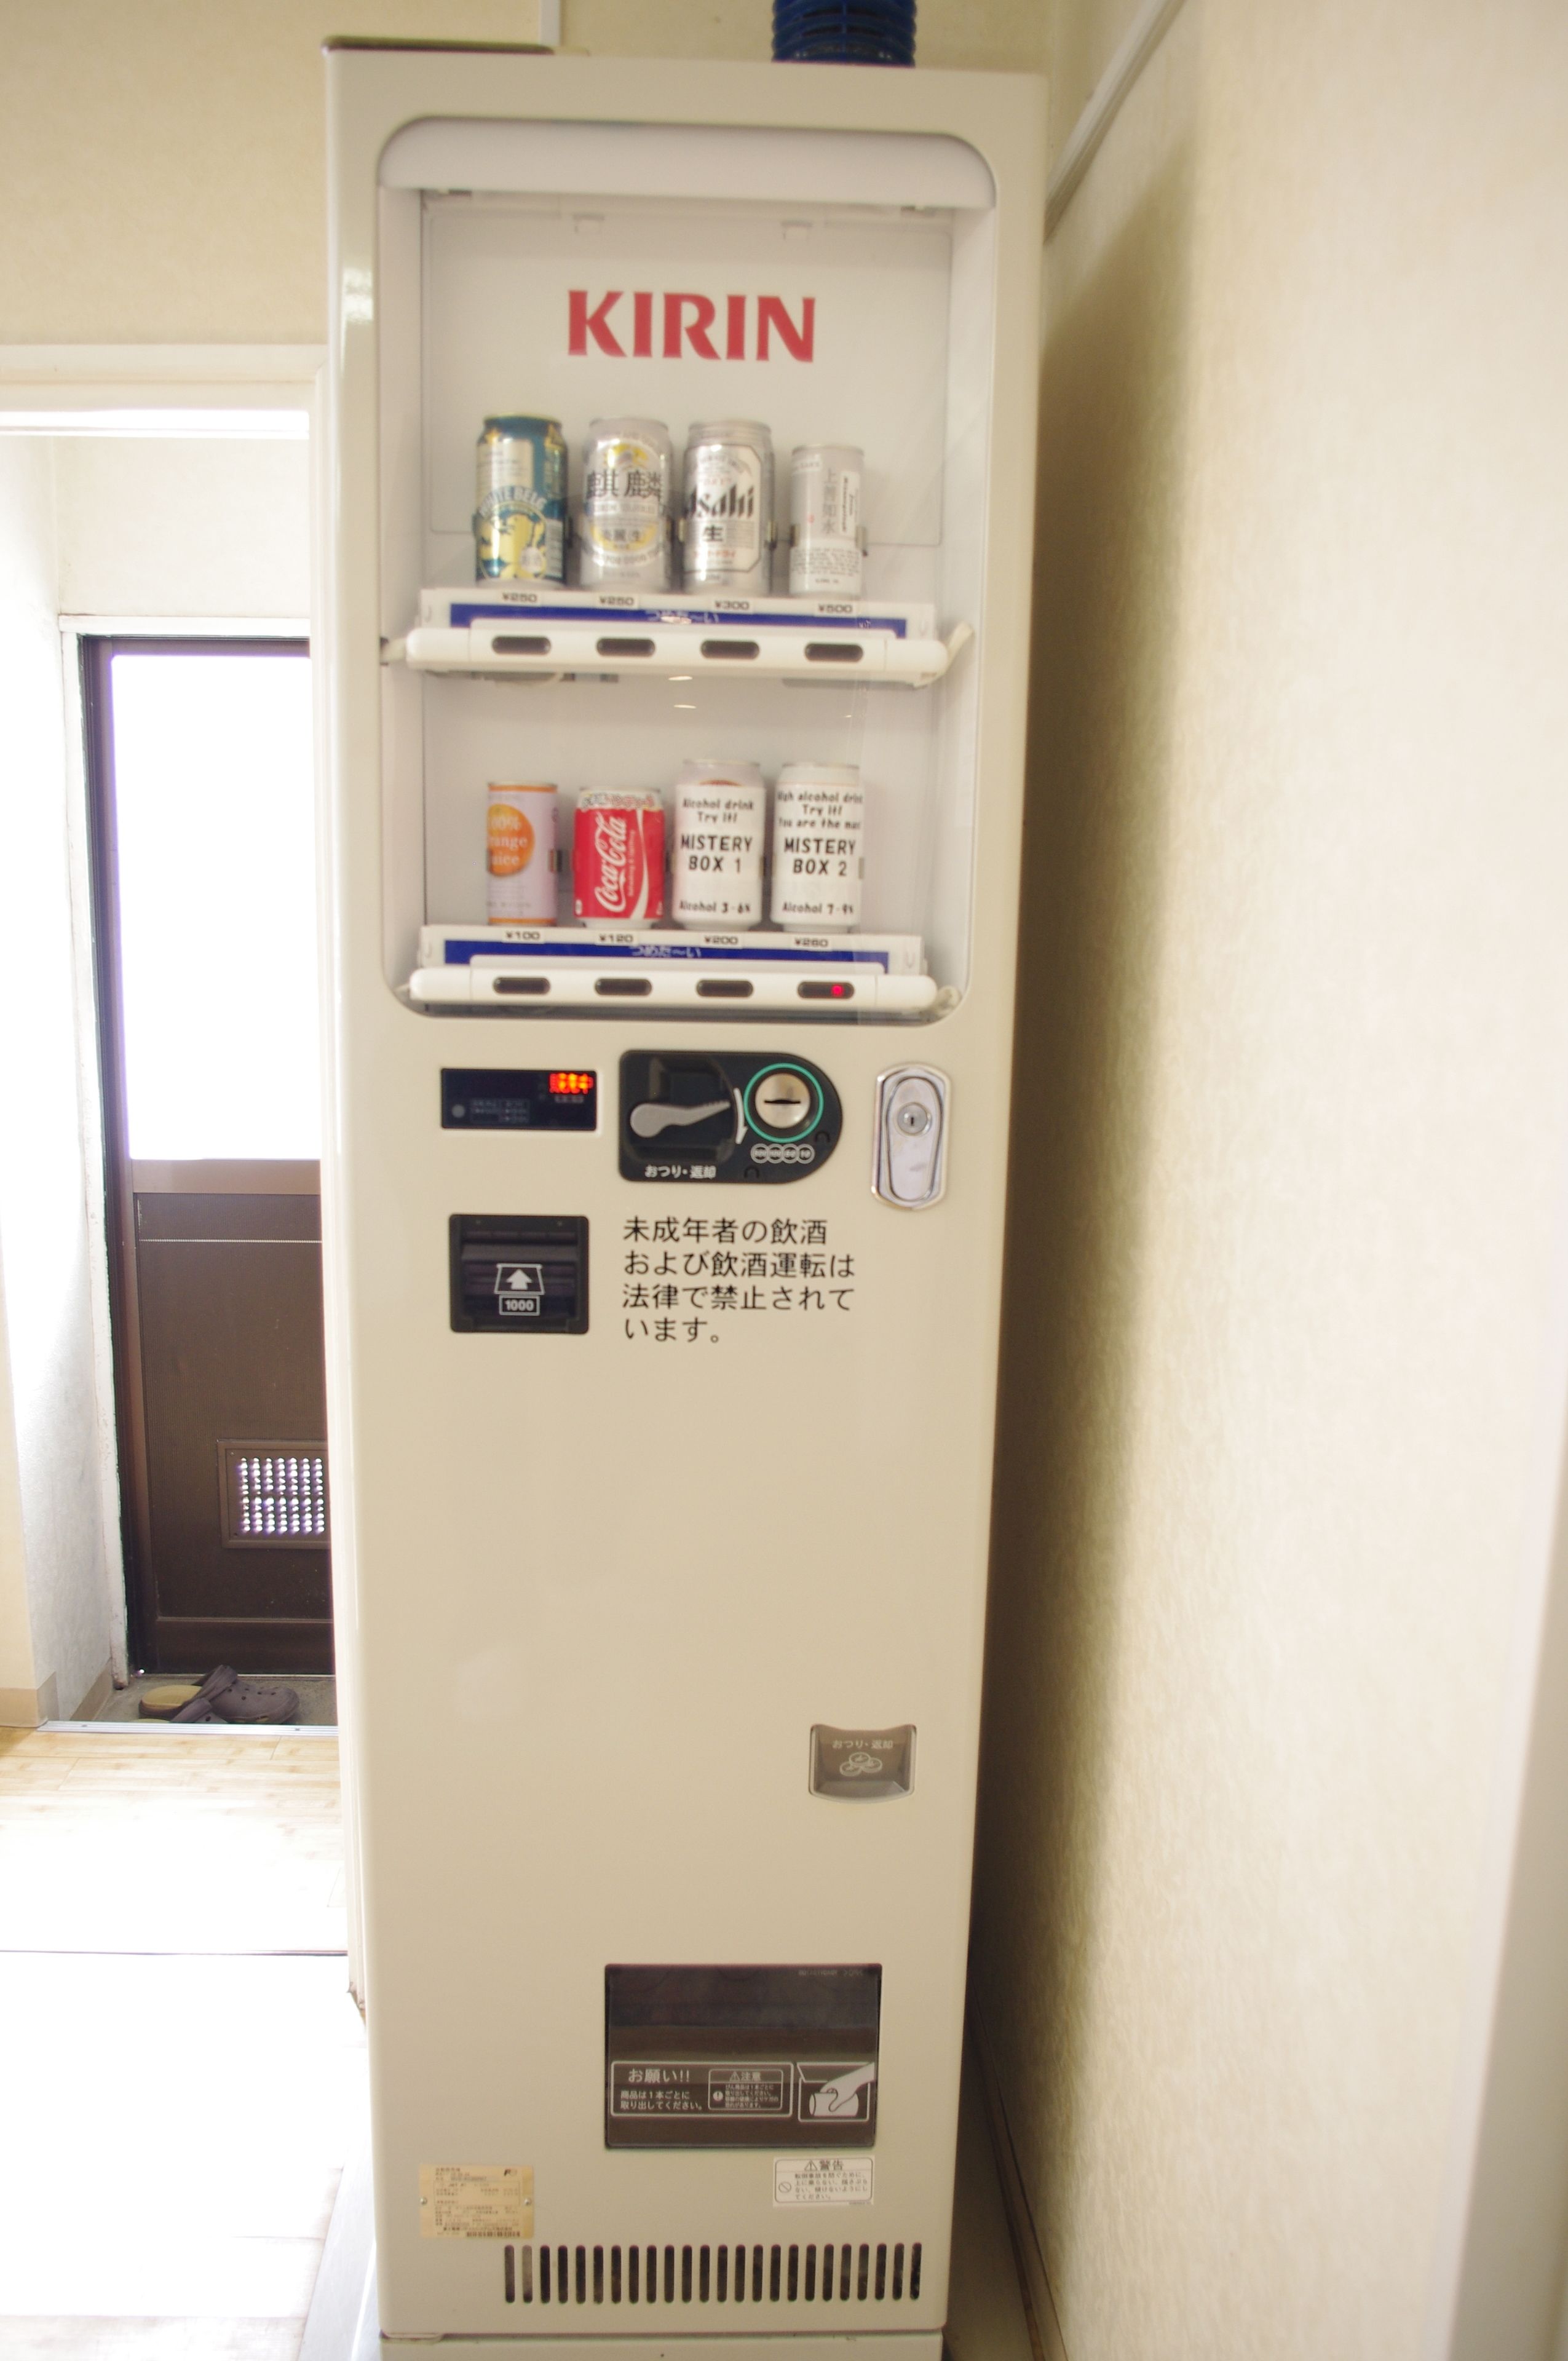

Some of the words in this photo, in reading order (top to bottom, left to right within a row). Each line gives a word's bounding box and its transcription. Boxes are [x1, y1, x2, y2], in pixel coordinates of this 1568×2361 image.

[568, 290, 815, 363] KIRIN
[703, 524, 723, 542] 生
[715, 600, 750, 611] ¥300
[680, 834, 753, 852] MISTERY
[784, 838, 856, 855] MISTERY
[688, 856, 724, 871] BOX
[735, 859, 742, 874] 1
[793, 859, 829, 874] BOX
[838, 861, 848, 876] 2
[505, 930, 540, 940] ¥100
[645, 1165, 716, 1179] おつり・返却
[623, 1216, 828, 1246] 未成年者の飲酒
[624, 1249, 855, 1279] および飲酒運転は
[505, 1299, 534, 1312] 1000
[622, 1283, 855, 1311] 法律で禁止されて
[625, 1316, 719, 1344] います。
[620, 2100, 703, 2111] 取り出してください。
